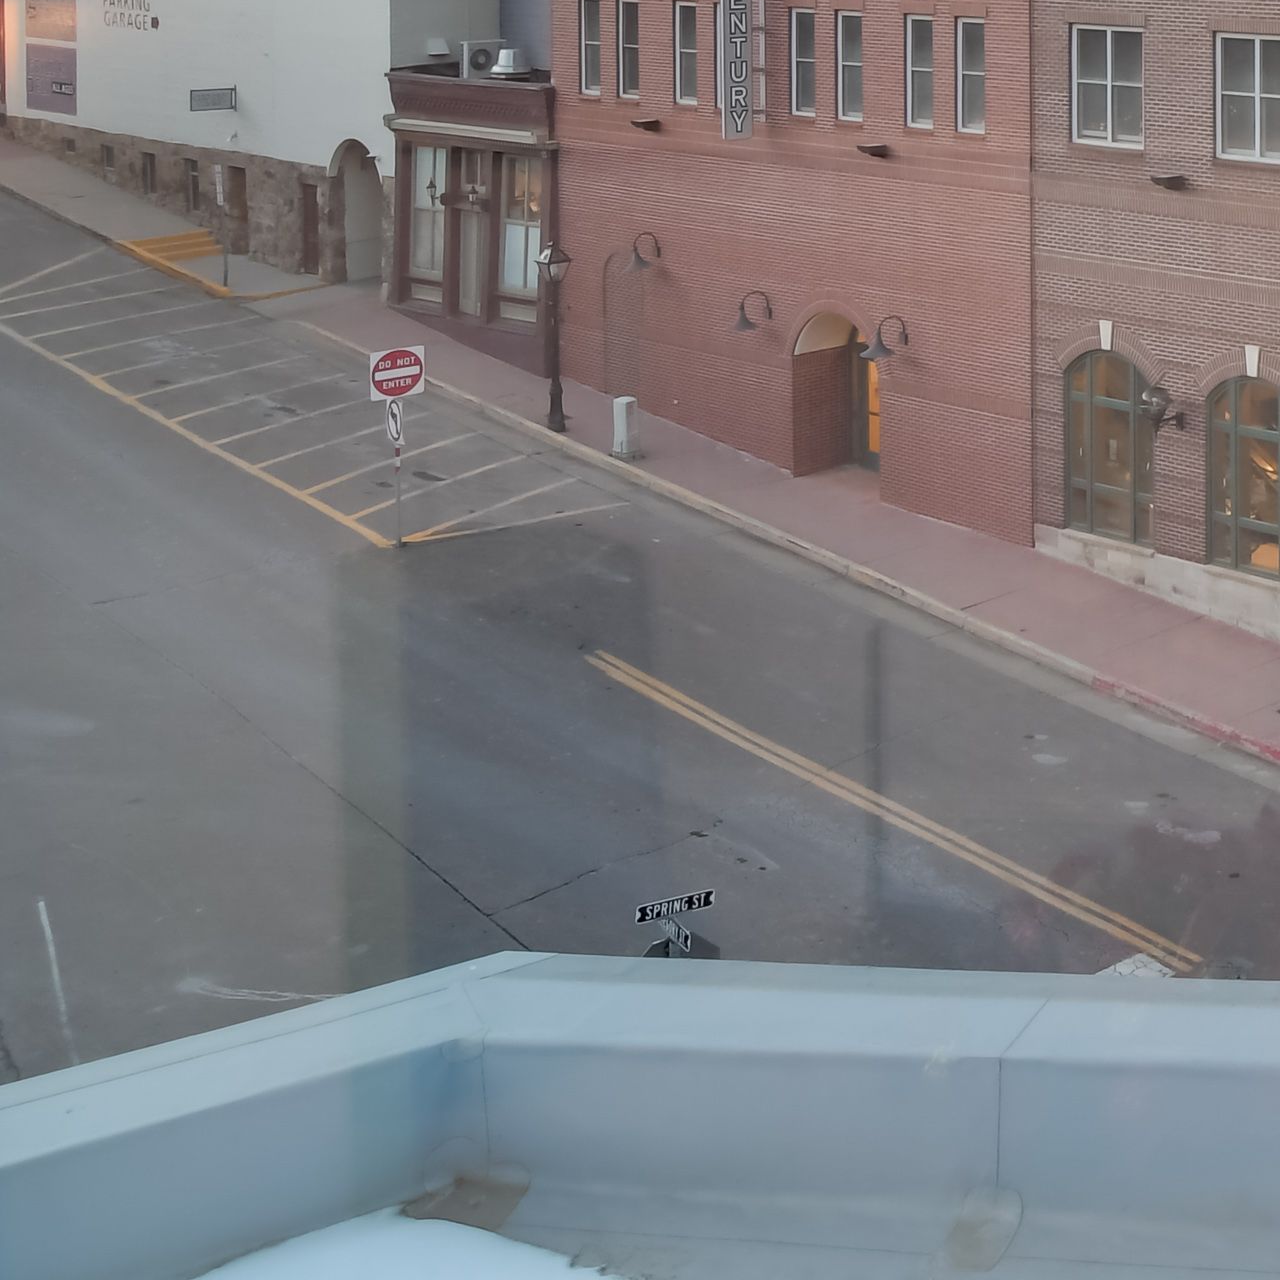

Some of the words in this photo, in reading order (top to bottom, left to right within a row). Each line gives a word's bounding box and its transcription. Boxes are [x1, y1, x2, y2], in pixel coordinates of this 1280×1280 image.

[104, 11, 148, 31] GARAGE
[378, 360, 391, 369] DO
[397, 356, 415, 366] NOT
[383, 378, 412, 389] ENTER
[645, 898, 688, 920] SPRING
[692, 893, 706, 909] ST
